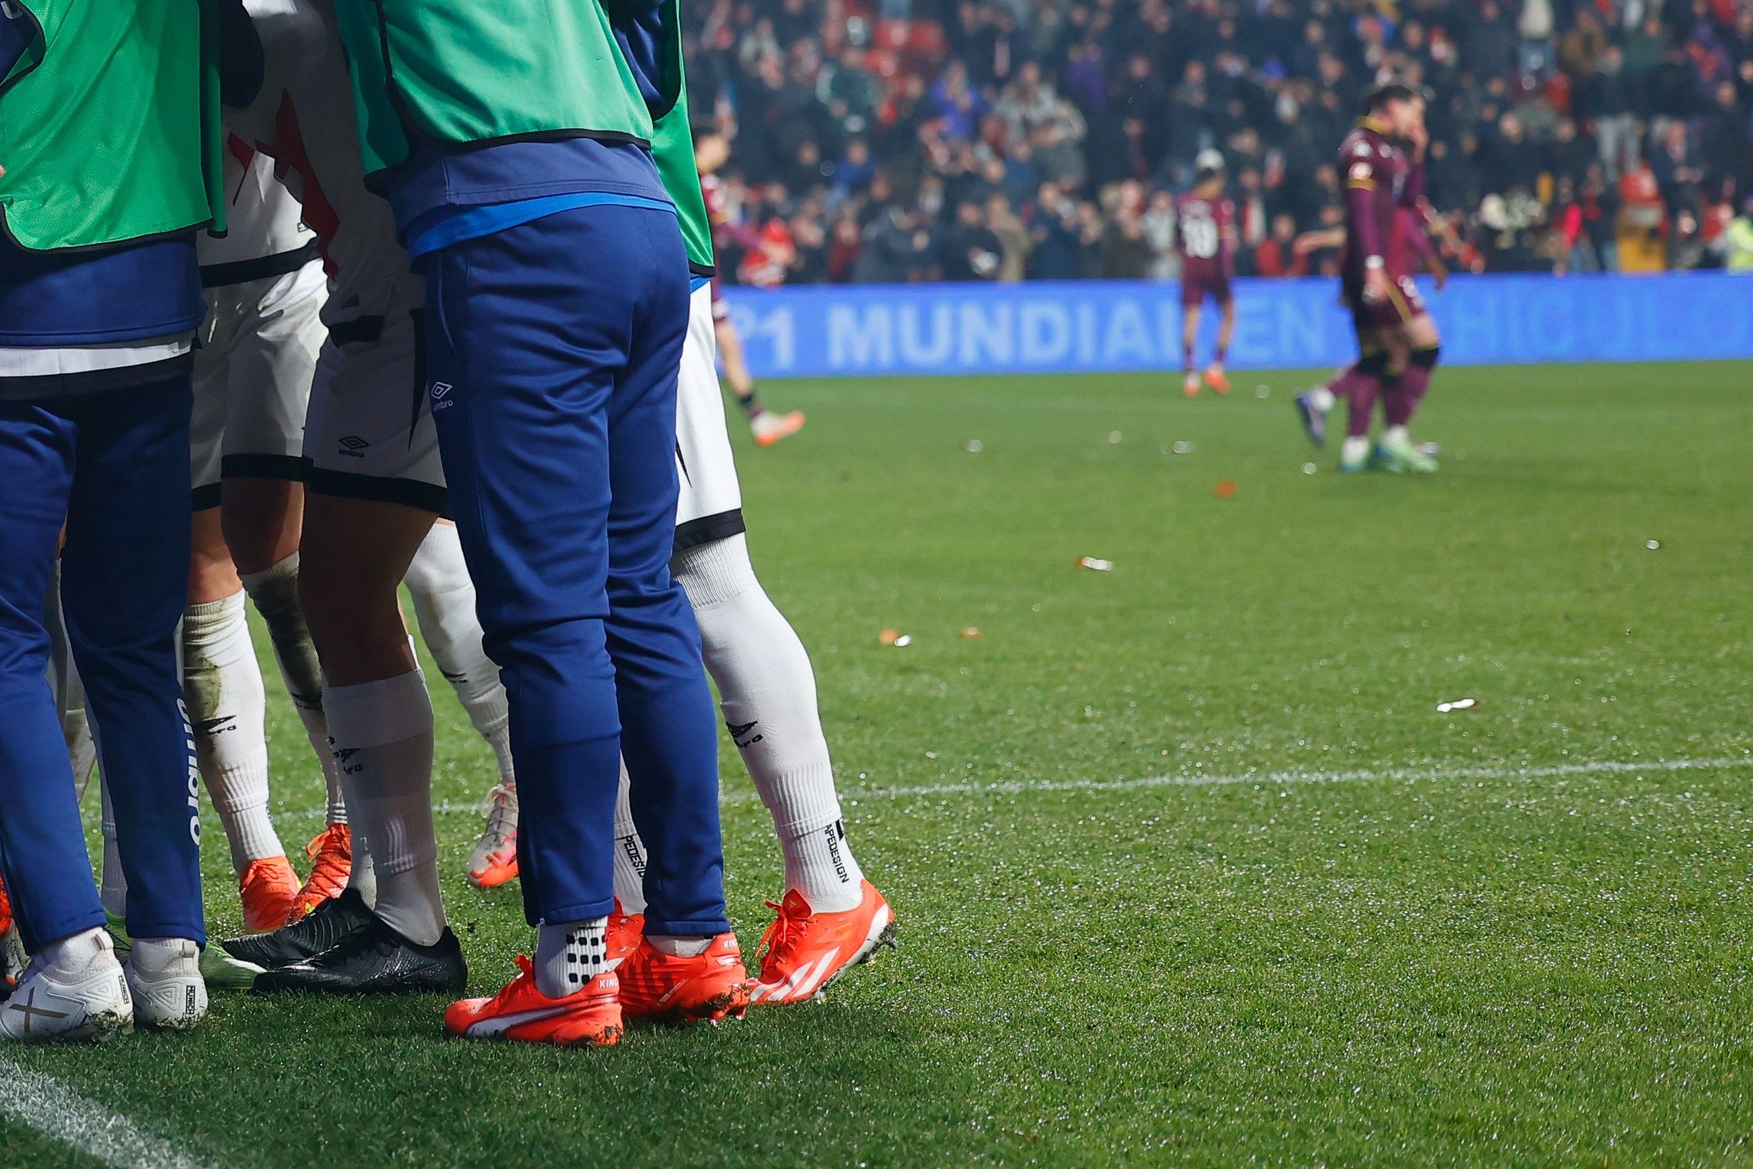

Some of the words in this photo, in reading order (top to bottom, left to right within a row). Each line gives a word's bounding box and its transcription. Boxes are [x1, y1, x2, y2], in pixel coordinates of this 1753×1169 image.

[826, 298, 1178, 370] MUNDIAL
[1232, 292, 1327, 361] EN
[1450, 287, 1749, 357] HICULO
[338, 449, 365, 458] umbro
